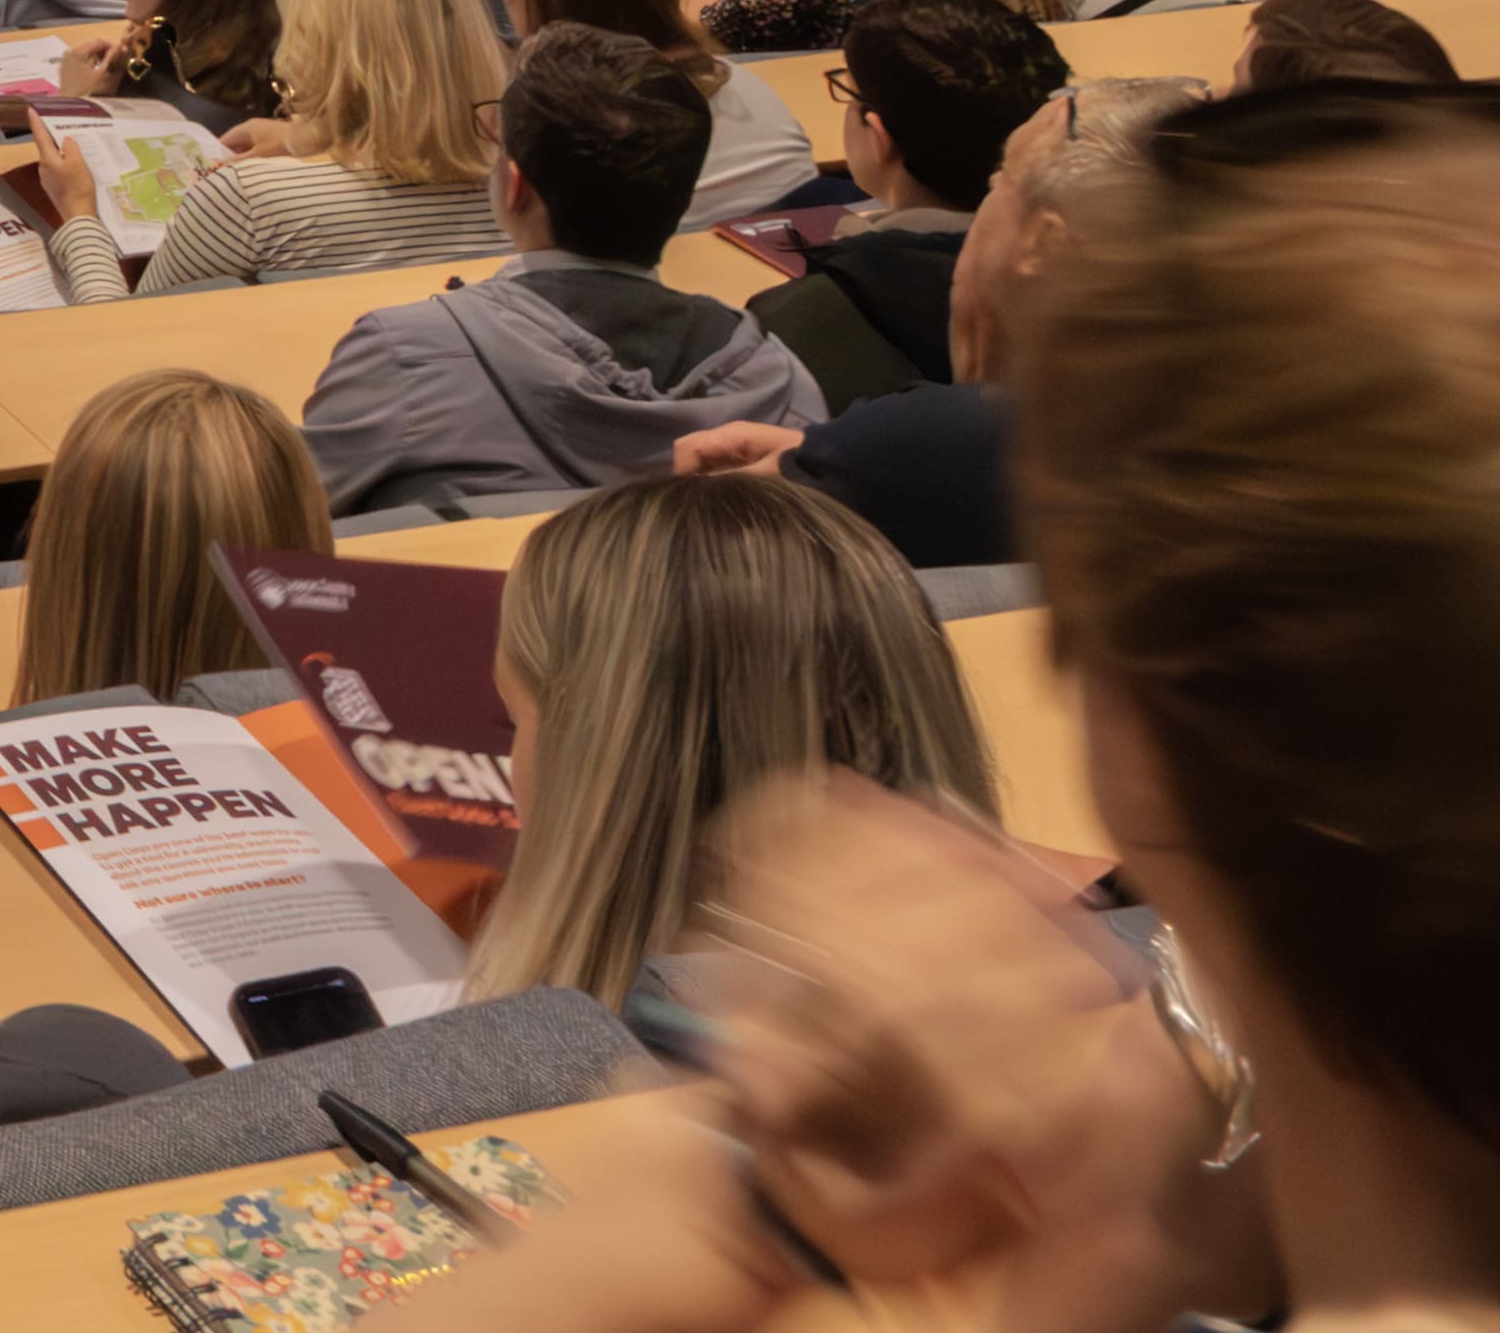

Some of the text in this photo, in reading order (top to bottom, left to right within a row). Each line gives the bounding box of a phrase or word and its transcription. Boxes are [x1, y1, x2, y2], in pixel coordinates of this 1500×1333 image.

[25, 757, 200, 808] MORE
[352, 734, 514, 806] OPEN
[55, 789, 298, 842] HAPPEN
